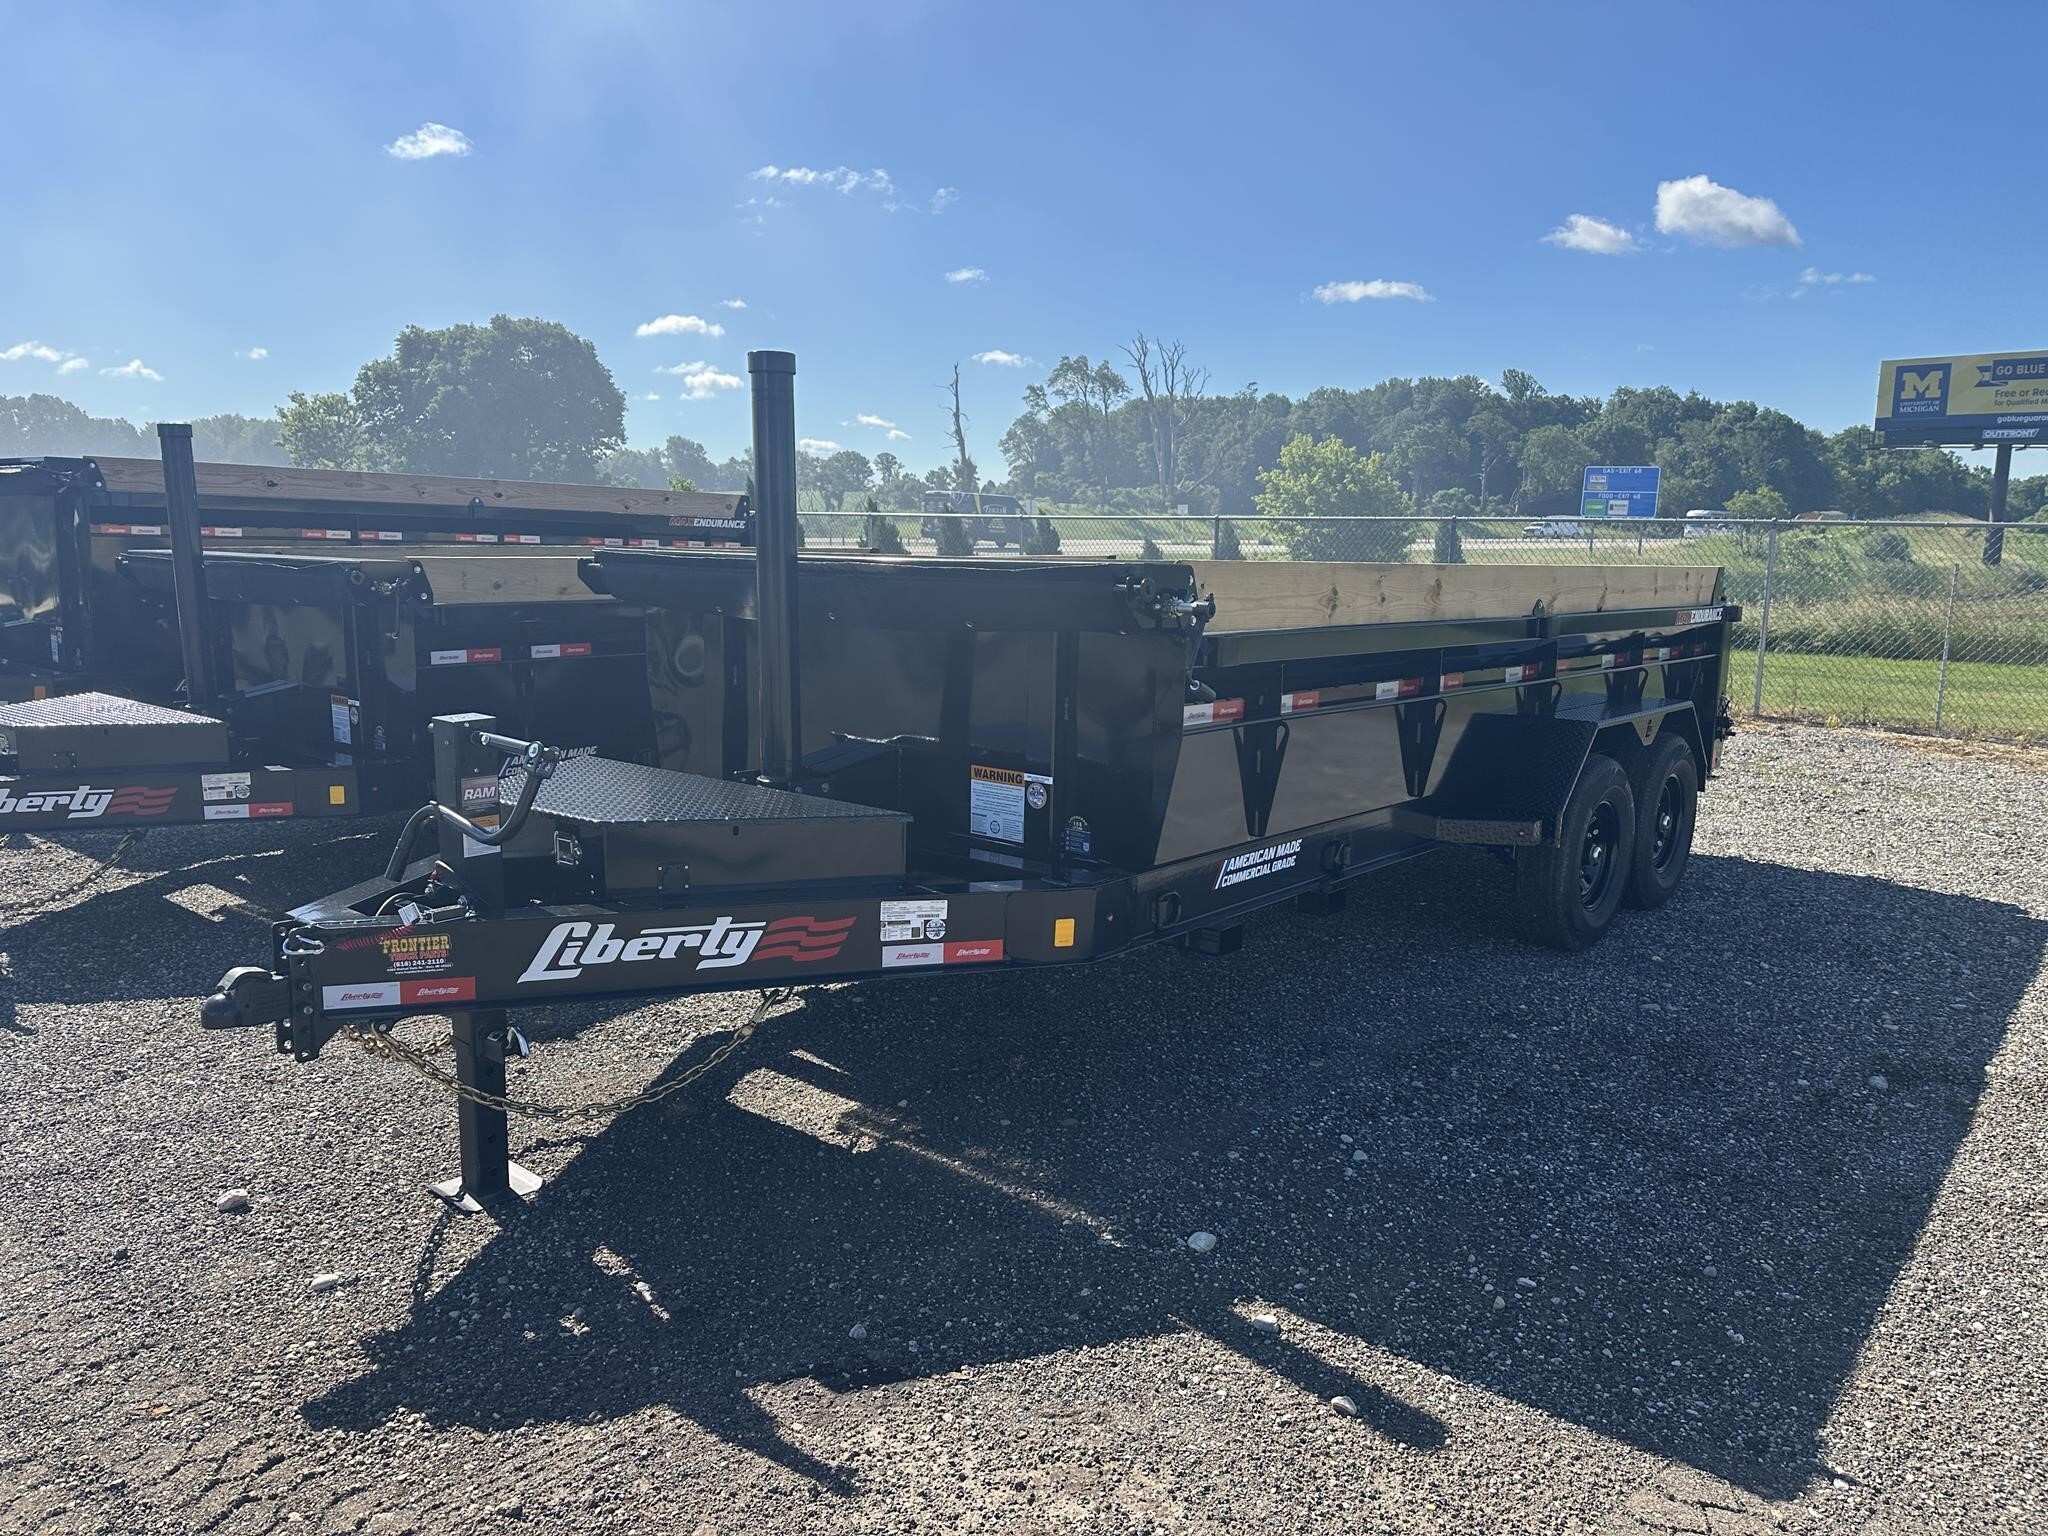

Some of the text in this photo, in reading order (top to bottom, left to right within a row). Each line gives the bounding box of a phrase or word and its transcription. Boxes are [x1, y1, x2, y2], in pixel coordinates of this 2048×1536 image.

[1996, 363, 2046, 376] GO BLUE
[1901, 370, 1944, 399] M
[1995, 389, 2017, 398] Free
[2019, 389, 2030, 398] or
[1900, 405, 1940, 413] MICHIGAN
[1984, 429, 2036, 438] OUTFRONT
[567, 745, 597, 759] MADE
[973, 767, 1023, 785] WARNING
[464, 786, 496, 800] RAM
[1227, 838, 1302, 872] AMERICAN MADE
[1221, 855, 1296, 888] COMMERCIAL GRADE
[383, 936, 449, 954] FRONTIER
[516, 916, 767, 984] Liberty
[341, 987, 447, 1001] Liberty Liberty
